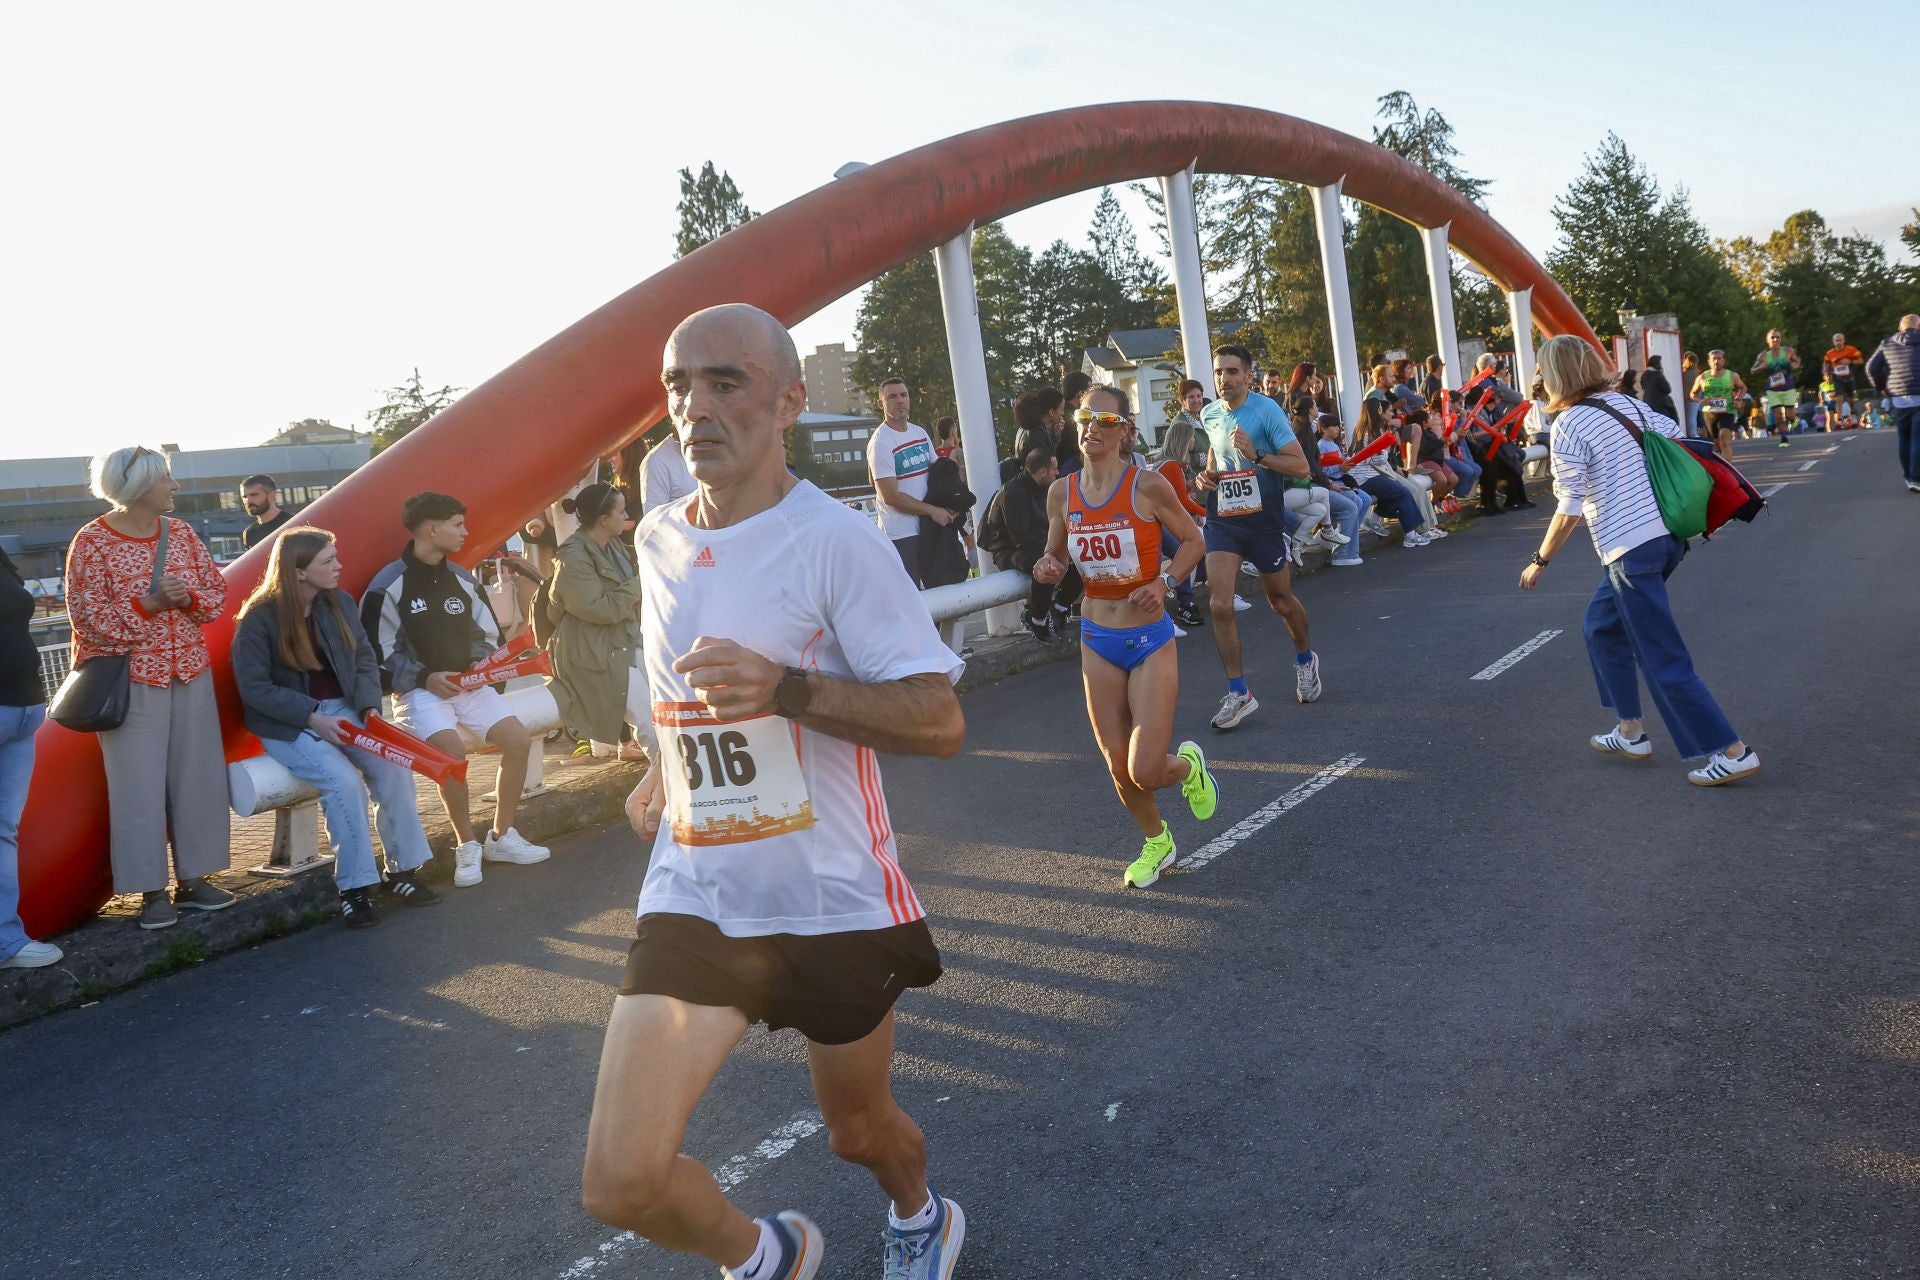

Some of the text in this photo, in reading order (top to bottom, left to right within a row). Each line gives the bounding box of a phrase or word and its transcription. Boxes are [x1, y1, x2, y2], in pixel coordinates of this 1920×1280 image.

[1077, 534, 1122, 562] 260
[460, 672, 488, 686] MBA
[354, 734, 383, 753] MBA
[677, 730, 756, 790] 816
[689, 794, 759, 808] ARCOS COSTALES
